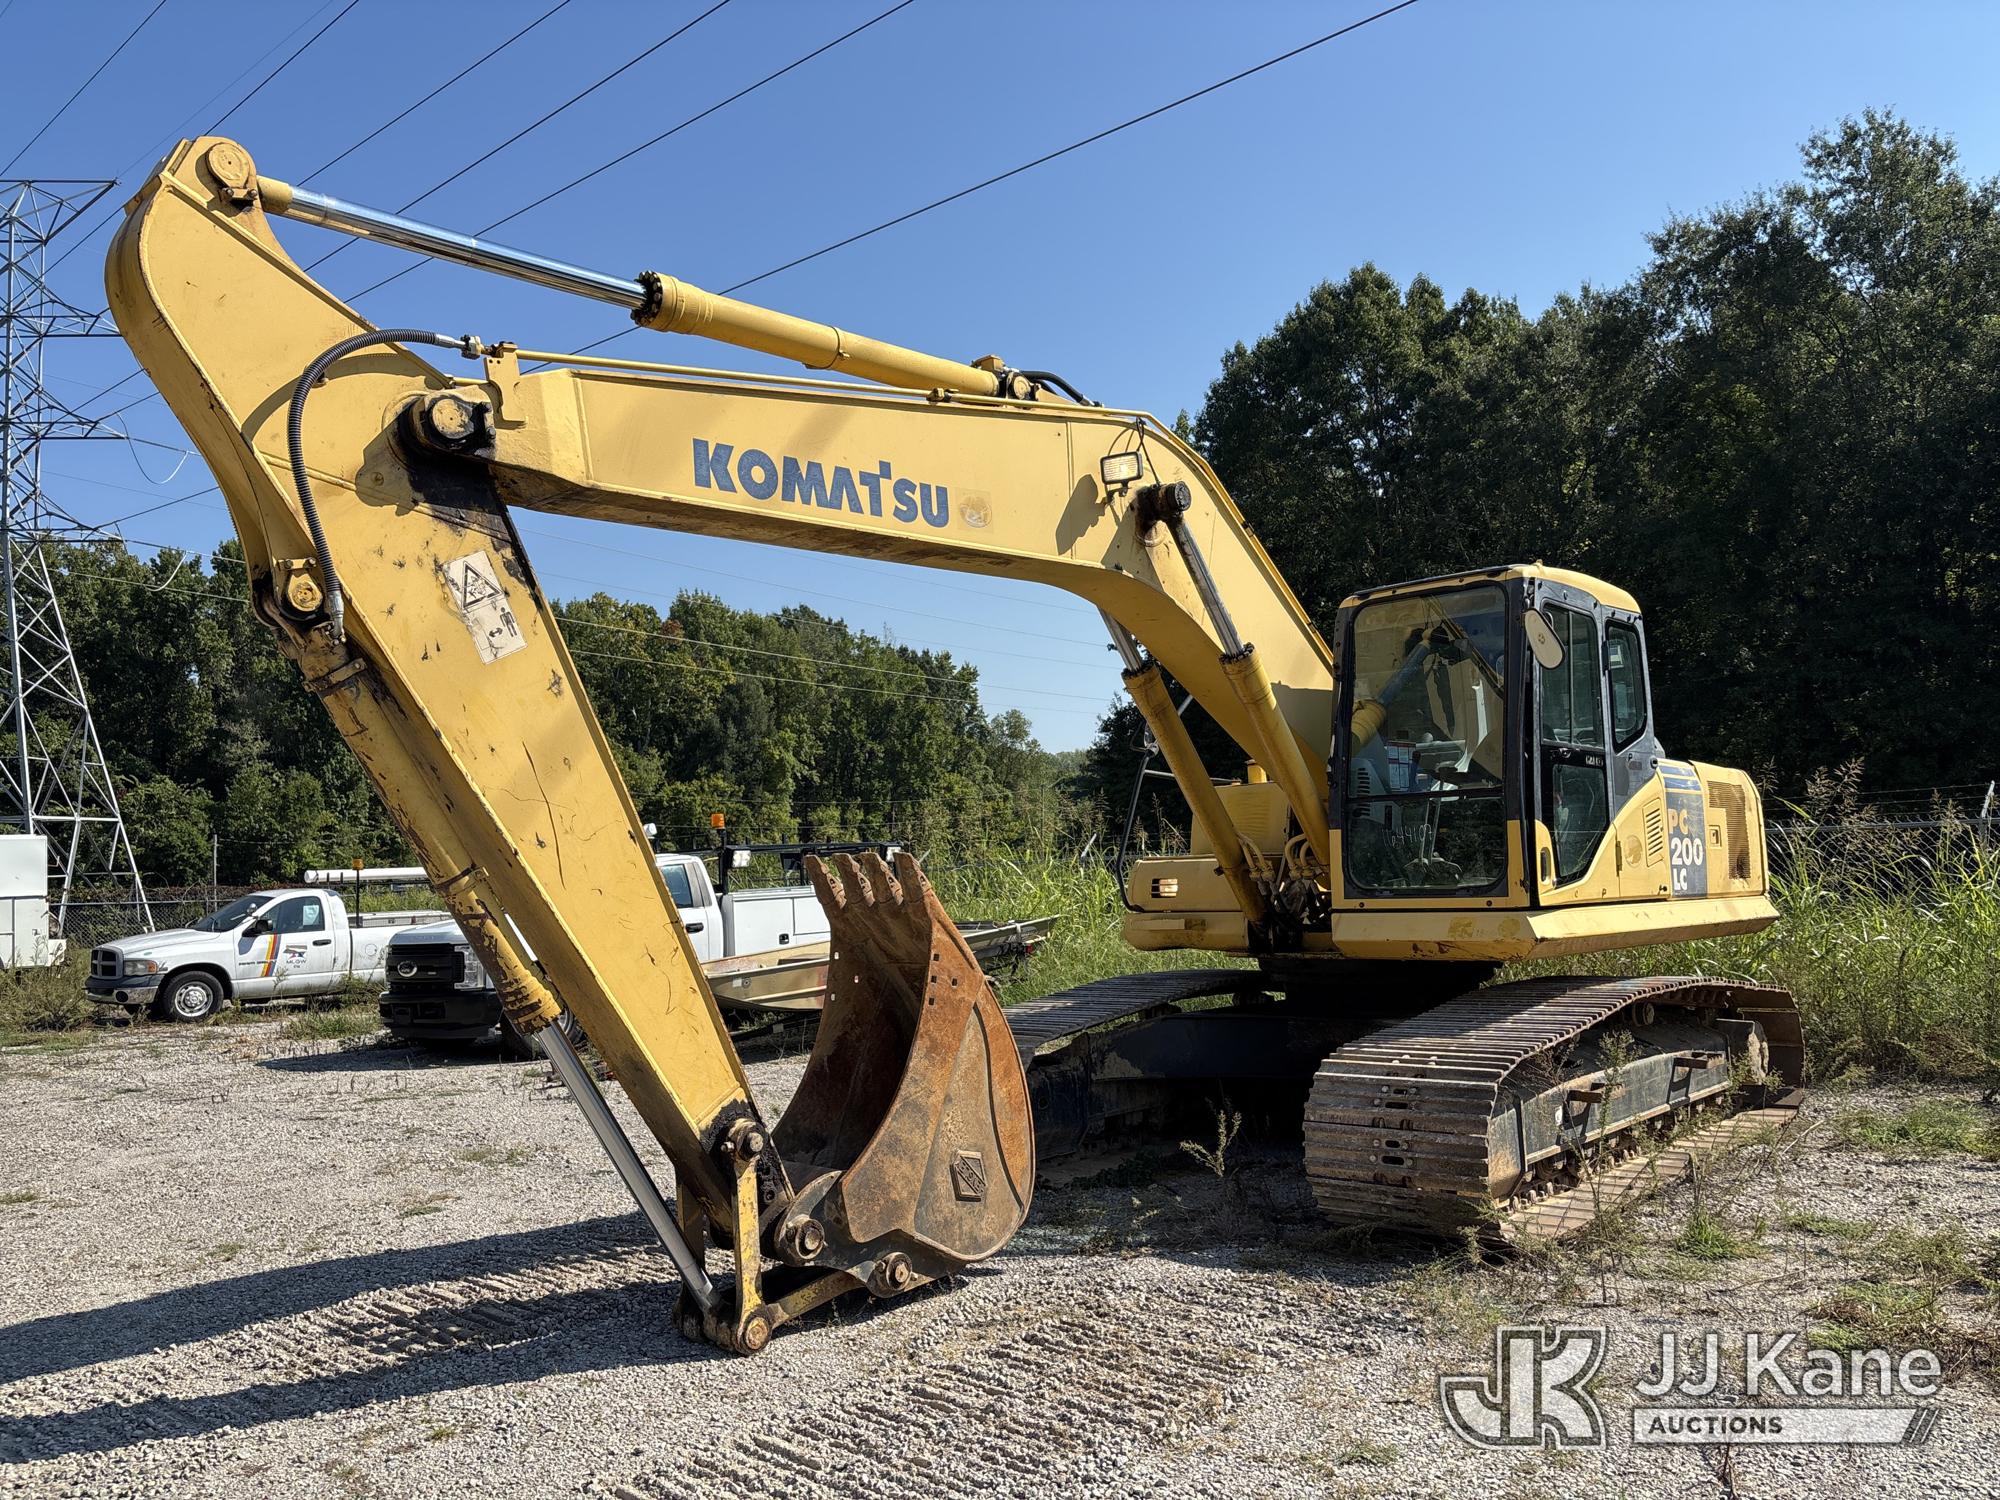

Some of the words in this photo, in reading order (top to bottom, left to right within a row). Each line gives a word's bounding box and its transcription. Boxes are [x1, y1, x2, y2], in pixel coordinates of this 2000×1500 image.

[691, 437, 950, 528] KOMATSU
[1667, 808, 1689, 835] PC
[1670, 837, 1704, 866] 200
[1672, 867, 1688, 891] LC
